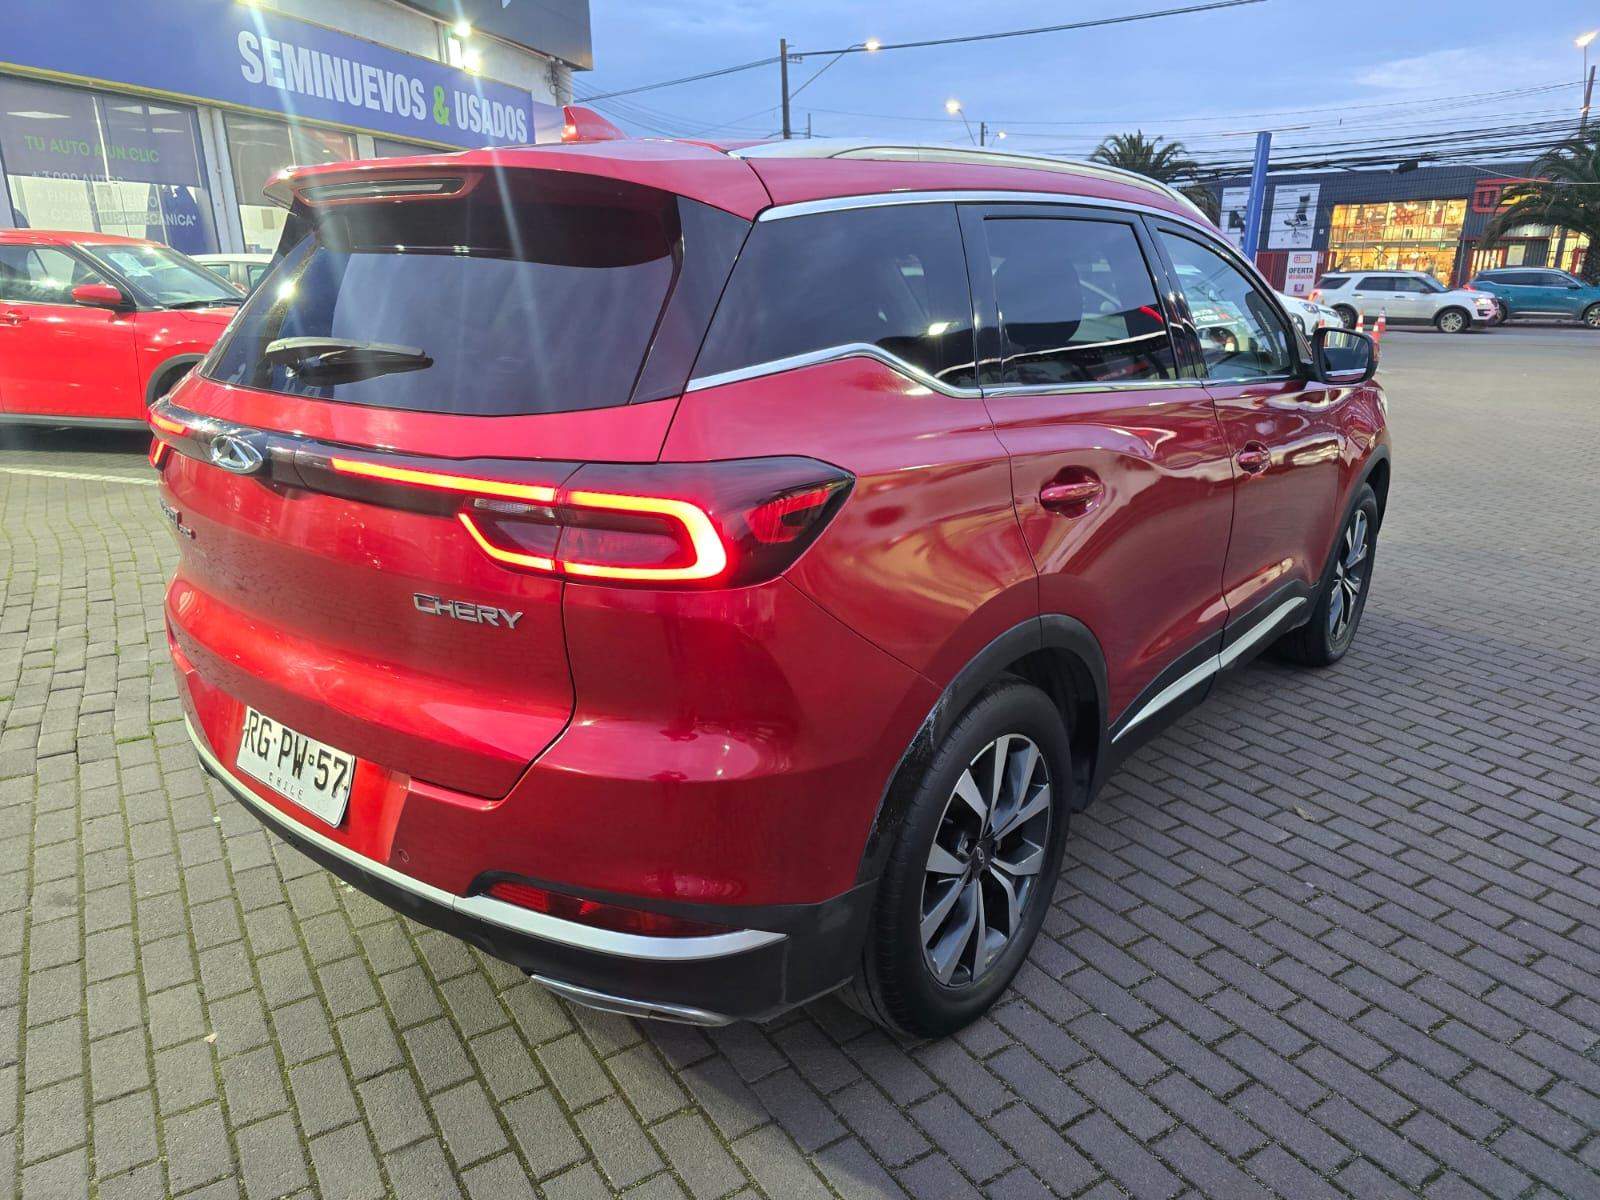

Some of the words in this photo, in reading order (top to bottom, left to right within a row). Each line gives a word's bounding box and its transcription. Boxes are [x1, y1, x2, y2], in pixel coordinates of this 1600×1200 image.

[237, 30, 426, 121] SEMINUEVOS
[432, 85, 450, 126] &
[454, 90, 527, 144] USADOS
[25, 135, 46, 151] TU
[51, 138, 90, 156] AUTO
[108, 147, 127, 161] UN
[129, 148, 160, 163] CLIC
[413, 592, 523, 629] CHERY
[268, 771, 304, 800] CHILE
